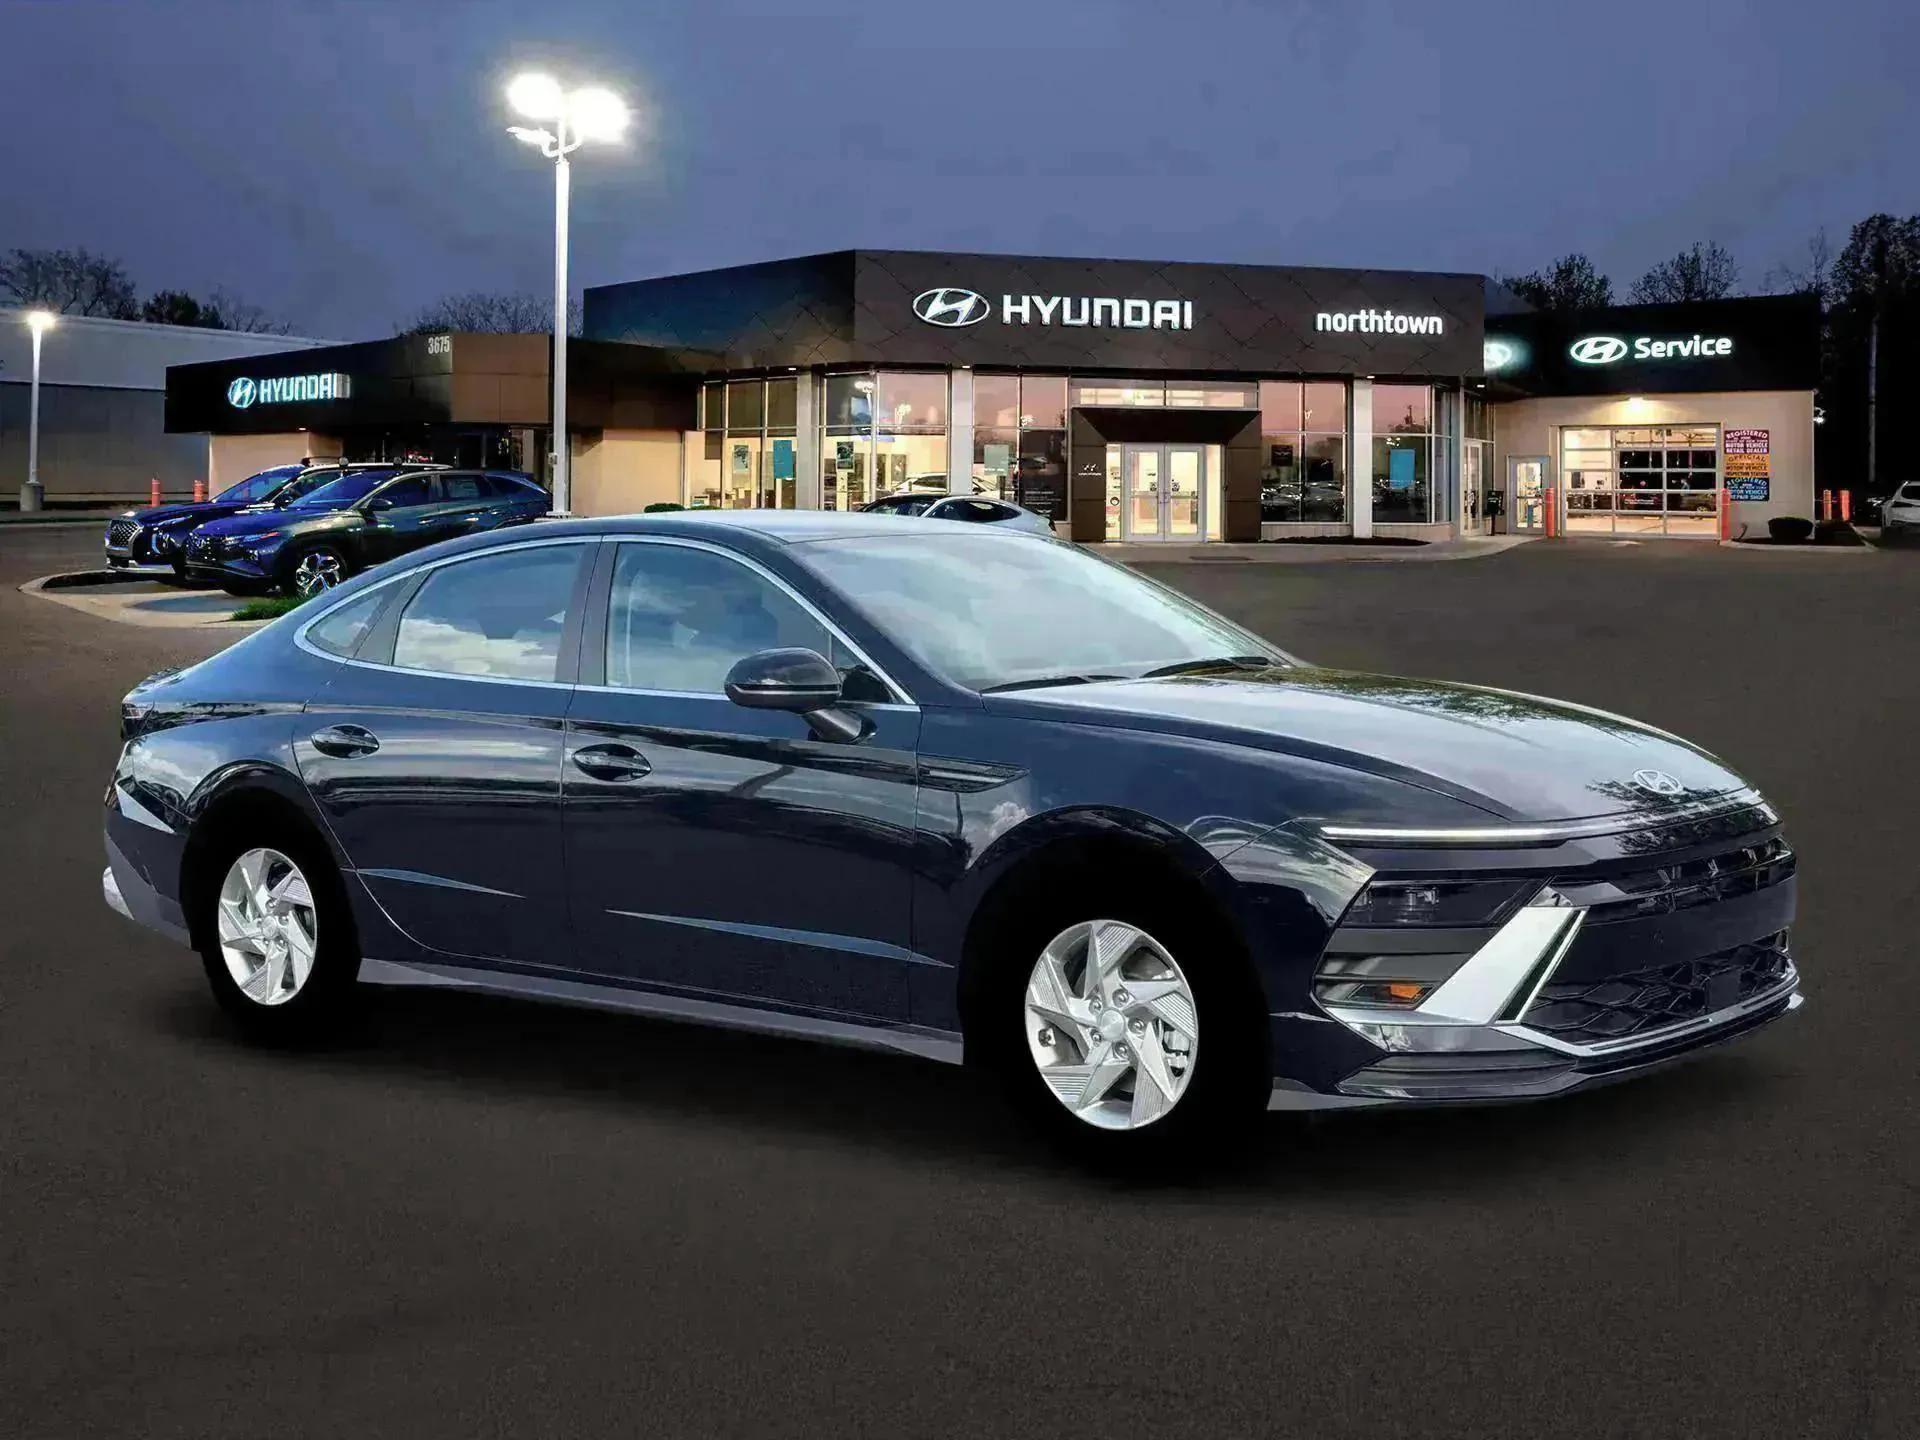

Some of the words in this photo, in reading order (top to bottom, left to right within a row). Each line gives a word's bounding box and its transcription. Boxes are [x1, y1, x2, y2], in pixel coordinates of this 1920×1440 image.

[1002, 294, 1193, 330] HYUNDAI
[1316, 309, 1443, 335] northtown
[428, 335, 450, 354] 3675
[1634, 334, 1732, 358] Service
[259, 373, 338, 403] HYUNDAI
[1726, 430, 1768, 439] REGISTERED
[1726, 477, 1767, 486] REGISTERED
